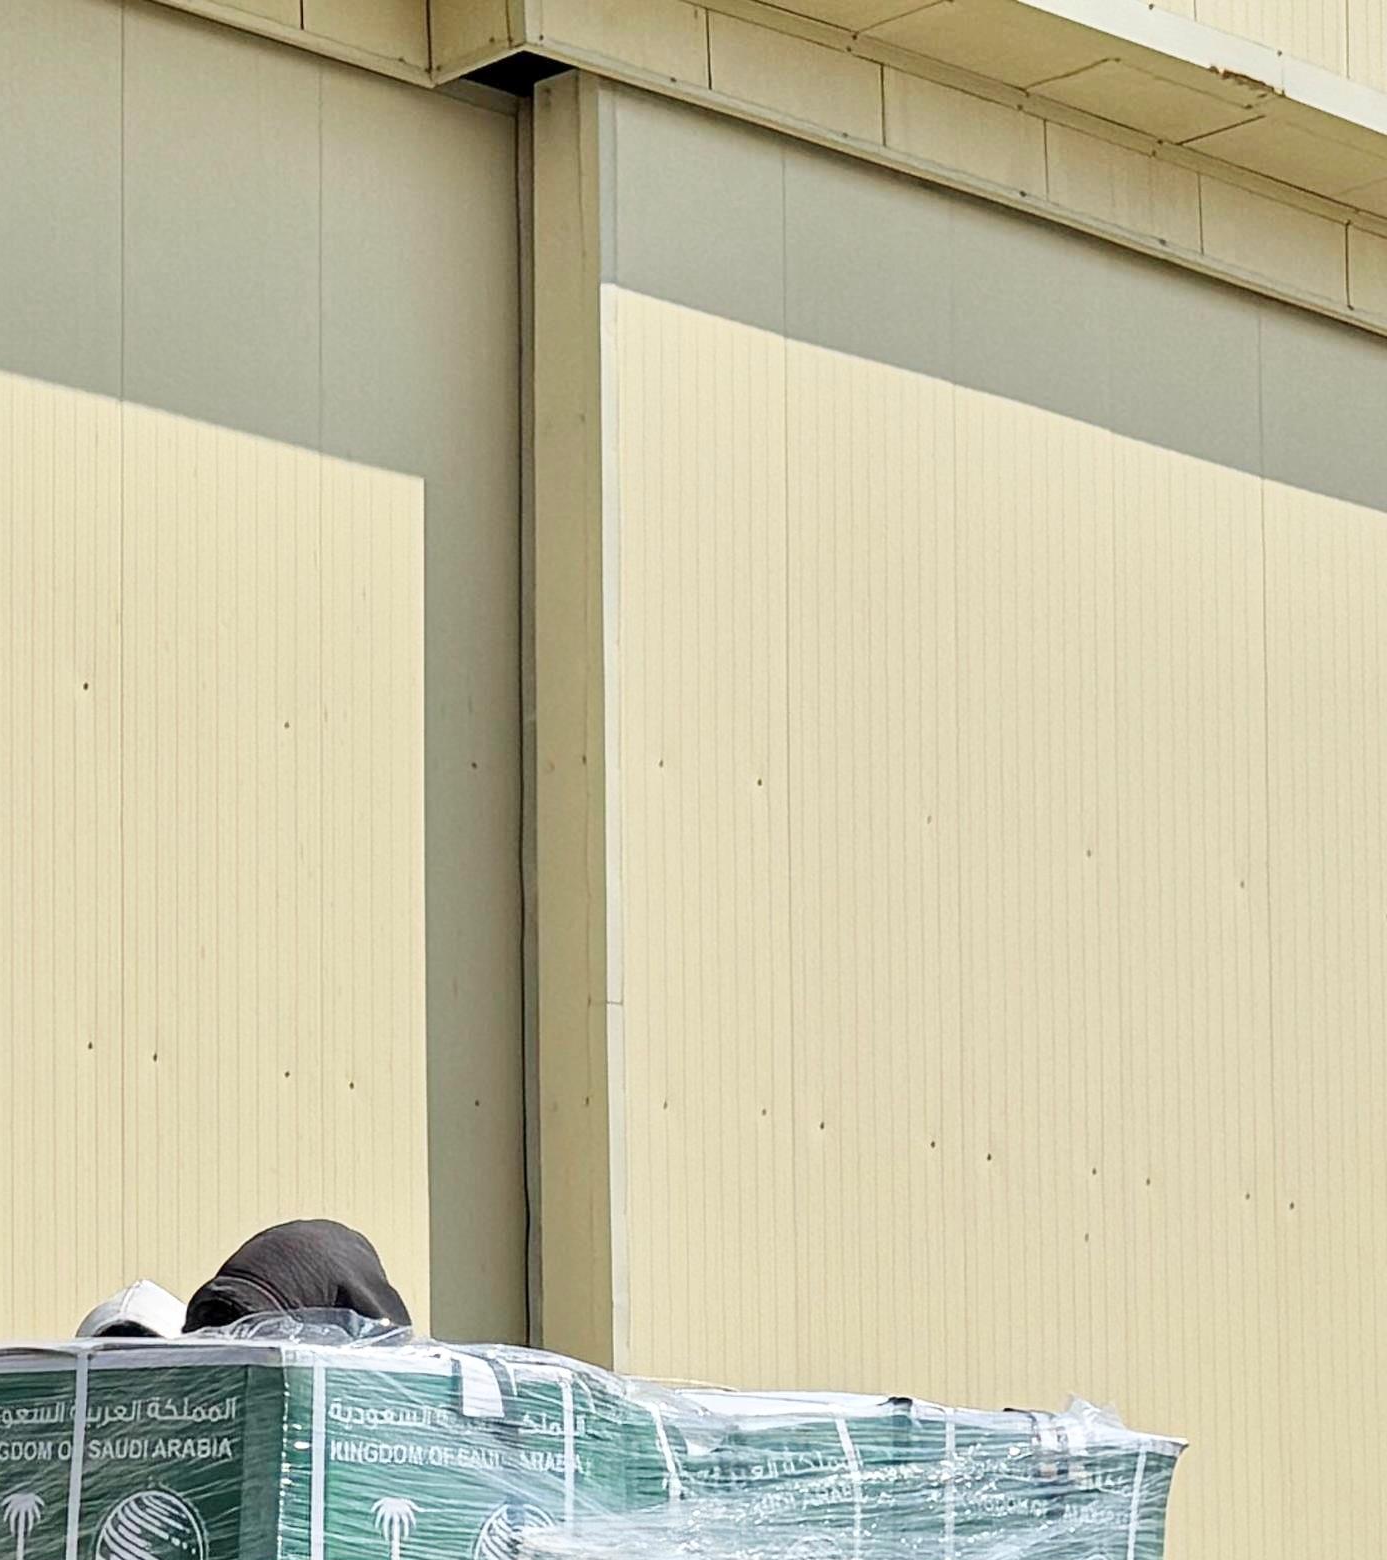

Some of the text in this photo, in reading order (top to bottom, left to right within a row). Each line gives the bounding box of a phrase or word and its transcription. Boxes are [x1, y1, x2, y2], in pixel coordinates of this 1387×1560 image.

[147, 1397, 237, 1422] المملكة
[88, 1437, 148, 1460] SAUDI
[151, 1435, 233, 1459] ARABIA
[330, 1440, 423, 1465] KINGDOM
